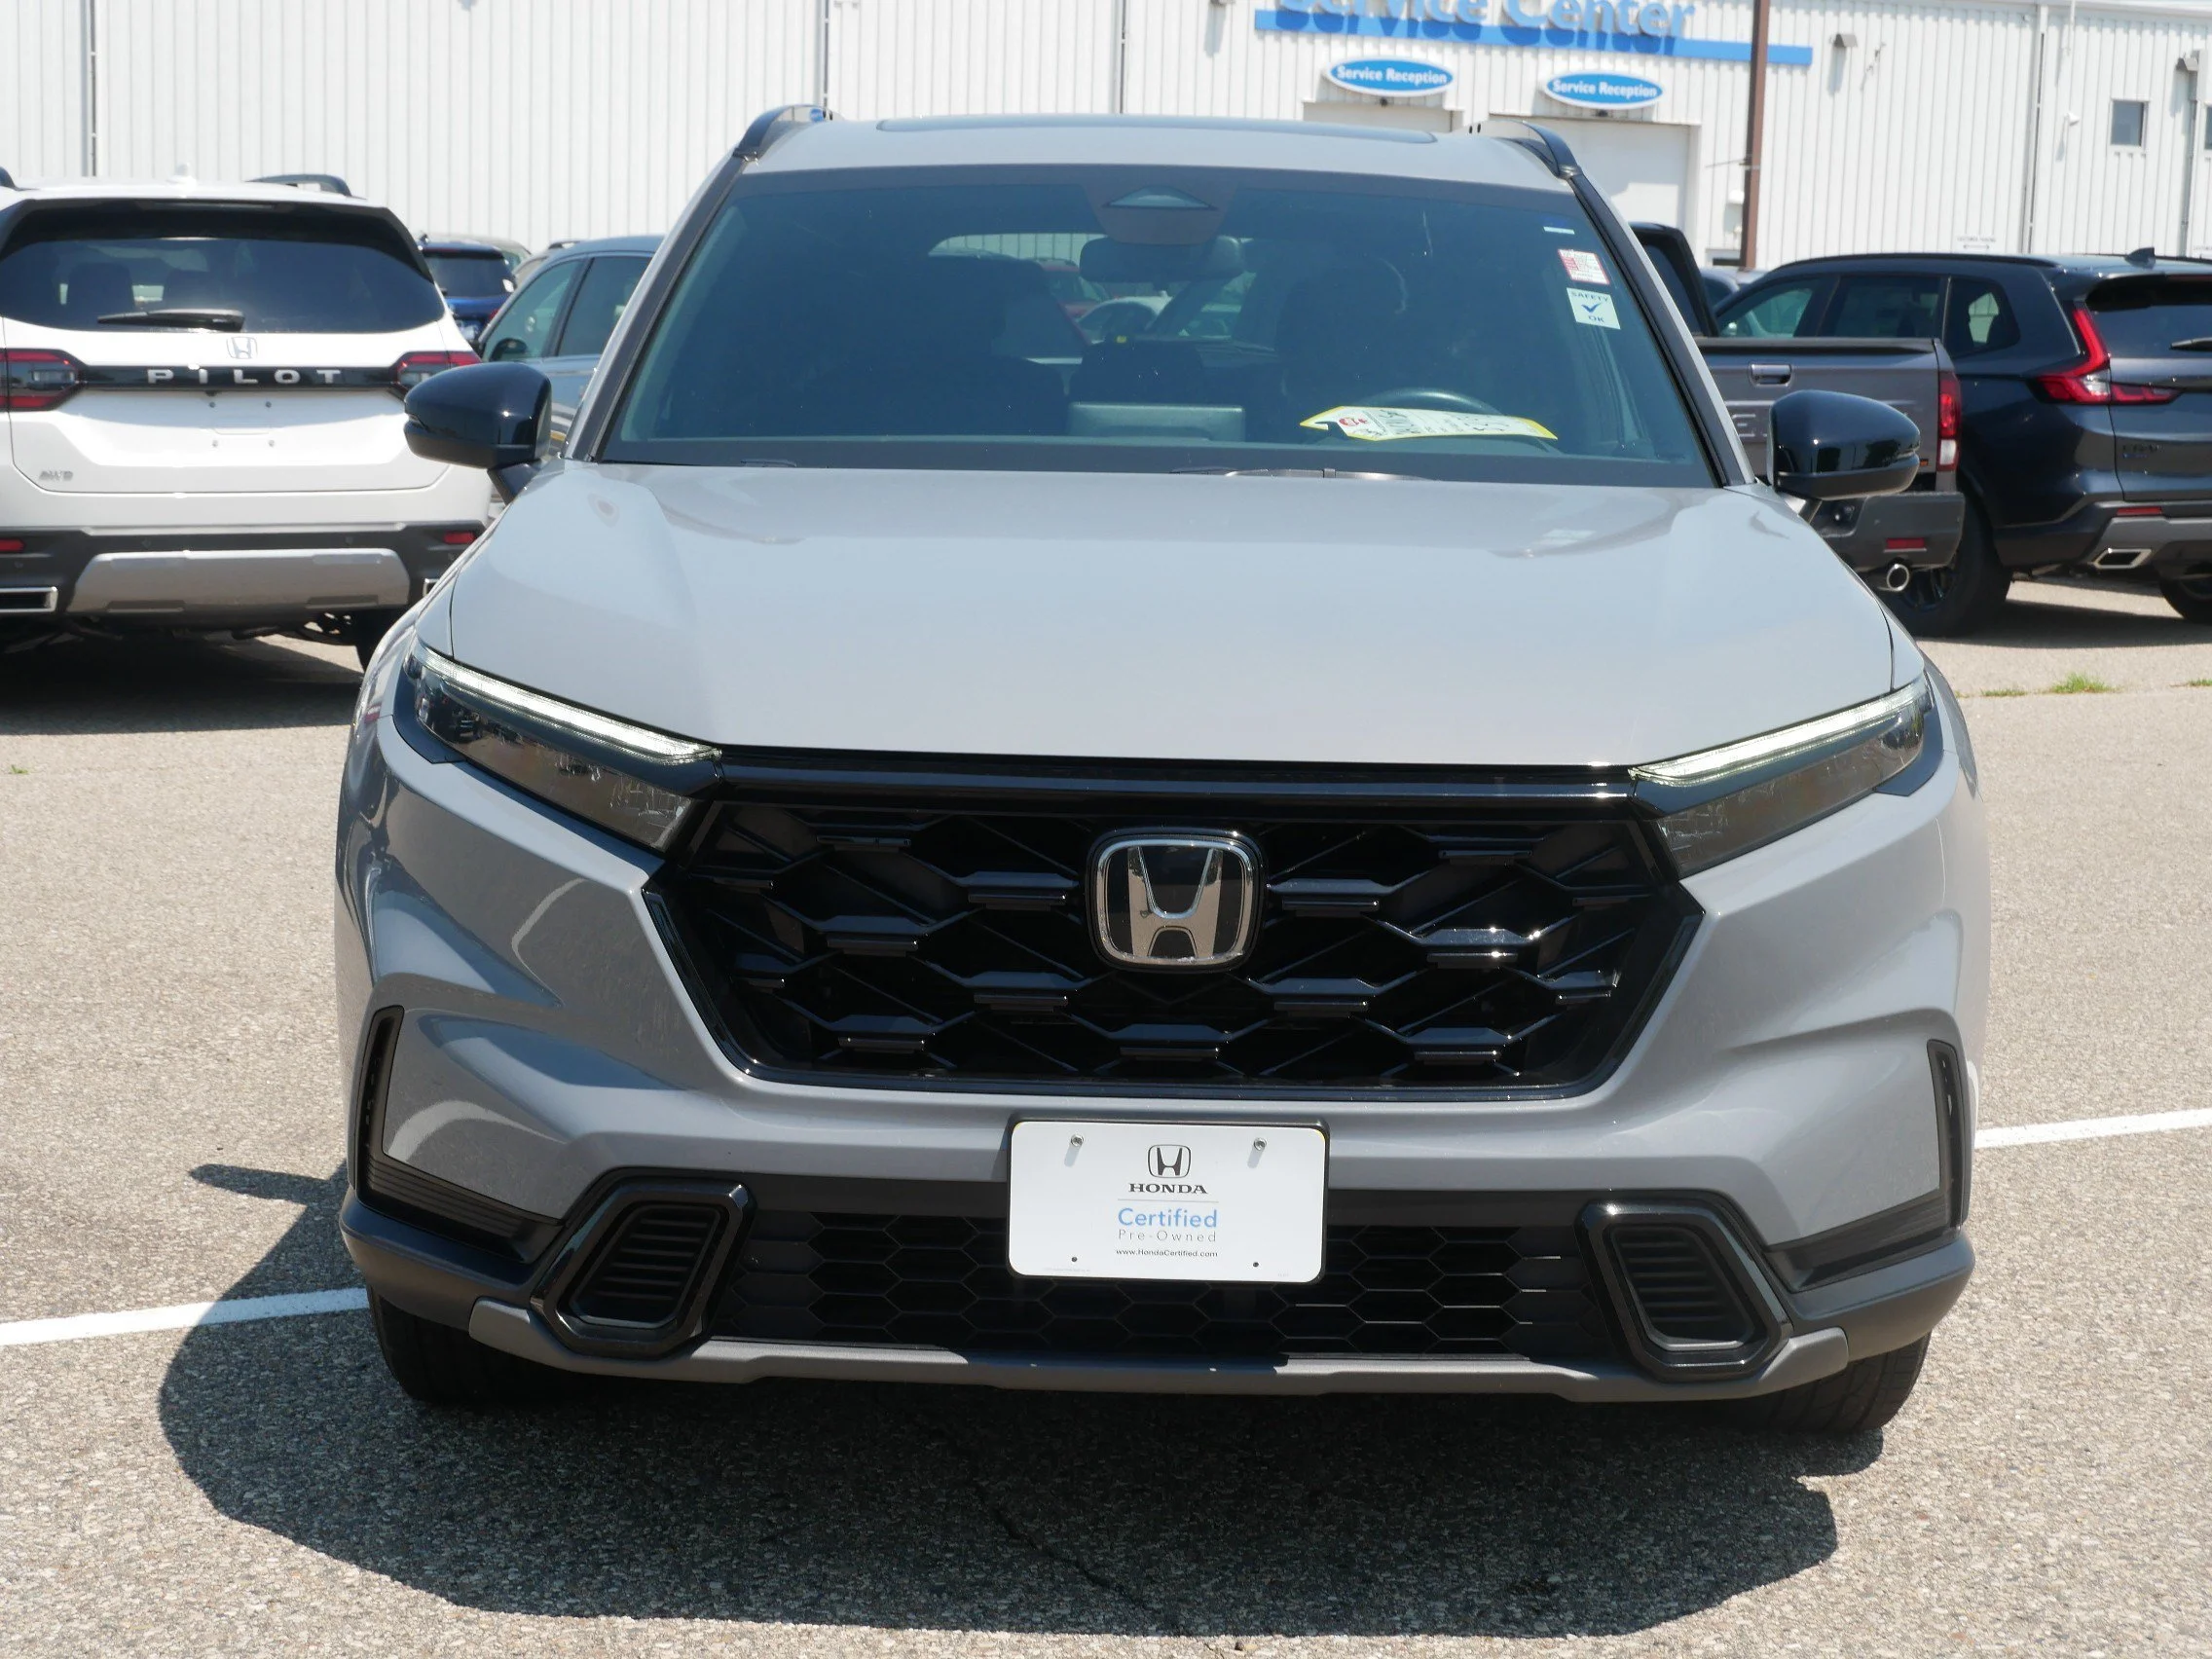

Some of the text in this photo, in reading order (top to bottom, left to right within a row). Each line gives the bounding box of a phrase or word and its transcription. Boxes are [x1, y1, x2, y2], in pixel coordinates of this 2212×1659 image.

[1277, 0, 1695, 37] vice Center
[1337, 65, 1448, 86] Service Reception
[1553, 79, 1657, 99] Service Reception
[1571, 291, 1608, 302] SAFETY
[147, 369, 341, 385] PILOT
[1128, 1183, 1208, 1195] HONDA
[1118, 1207, 1217, 1228] Certified
[1118, 1229, 1217, 1242] Pre-Owned
[1116, 1249, 1219, 1258] www.HondaCertified.com
